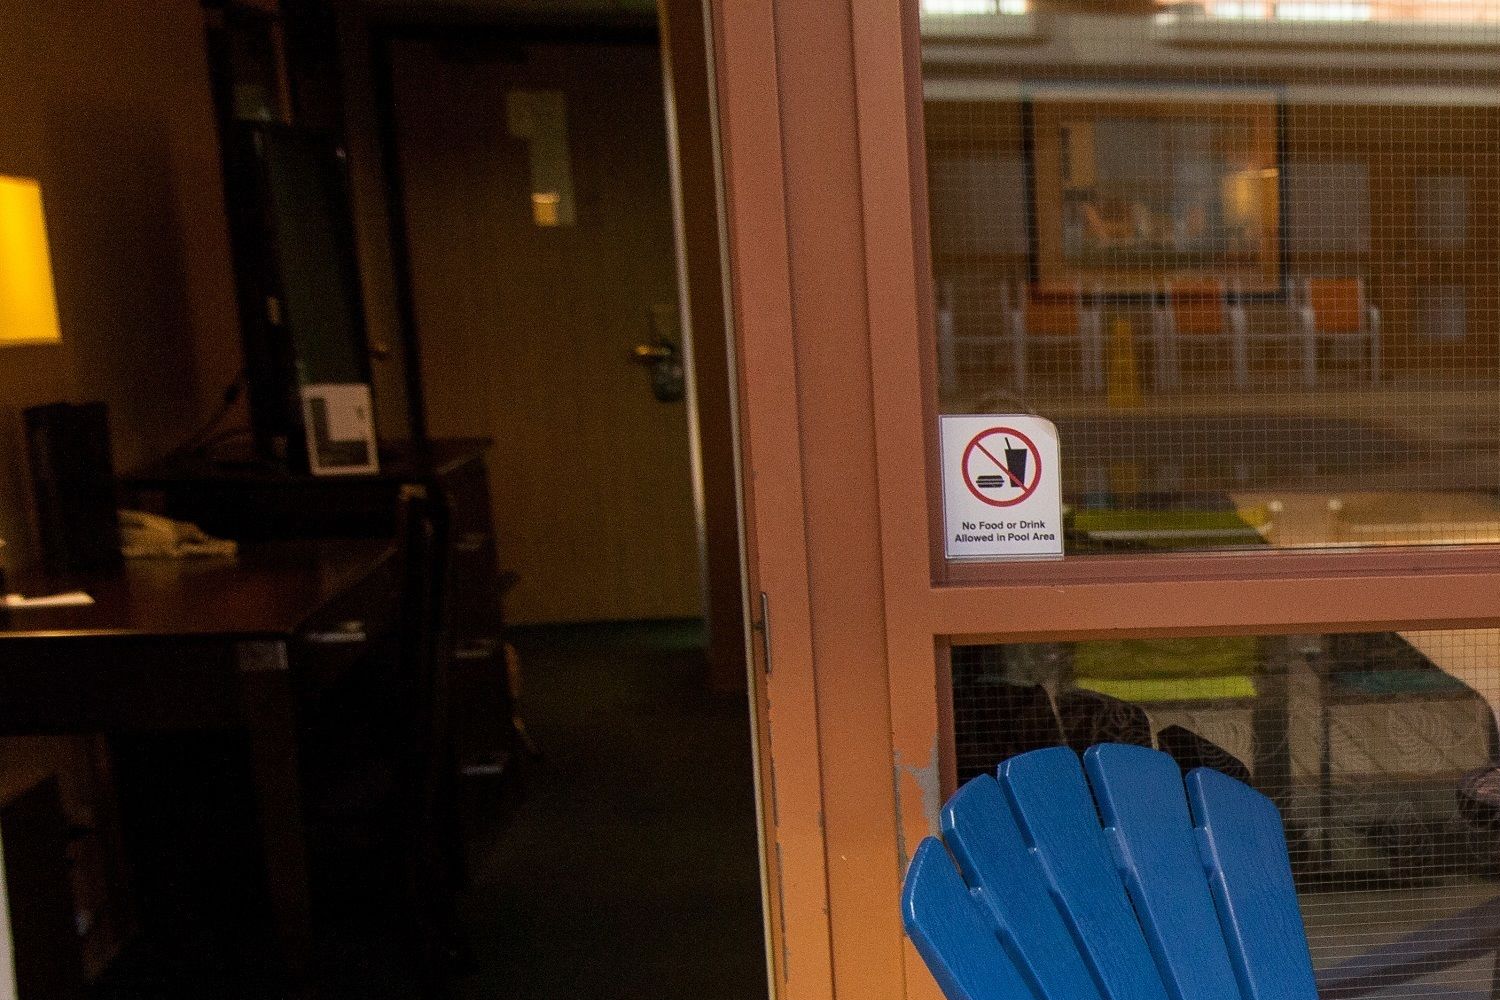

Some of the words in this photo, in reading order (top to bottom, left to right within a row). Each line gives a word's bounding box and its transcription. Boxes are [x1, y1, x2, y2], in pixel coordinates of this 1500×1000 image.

[962, 521, 976, 530] No
[979, 521, 1004, 530] Food
[1020, 520, 1046, 529] Drink
[955, 533, 994, 542] Allowed
[997, 533, 1006, 541] in
[1008, 533, 1030, 541] Pool
[1032, 532, 1055, 541] Area
